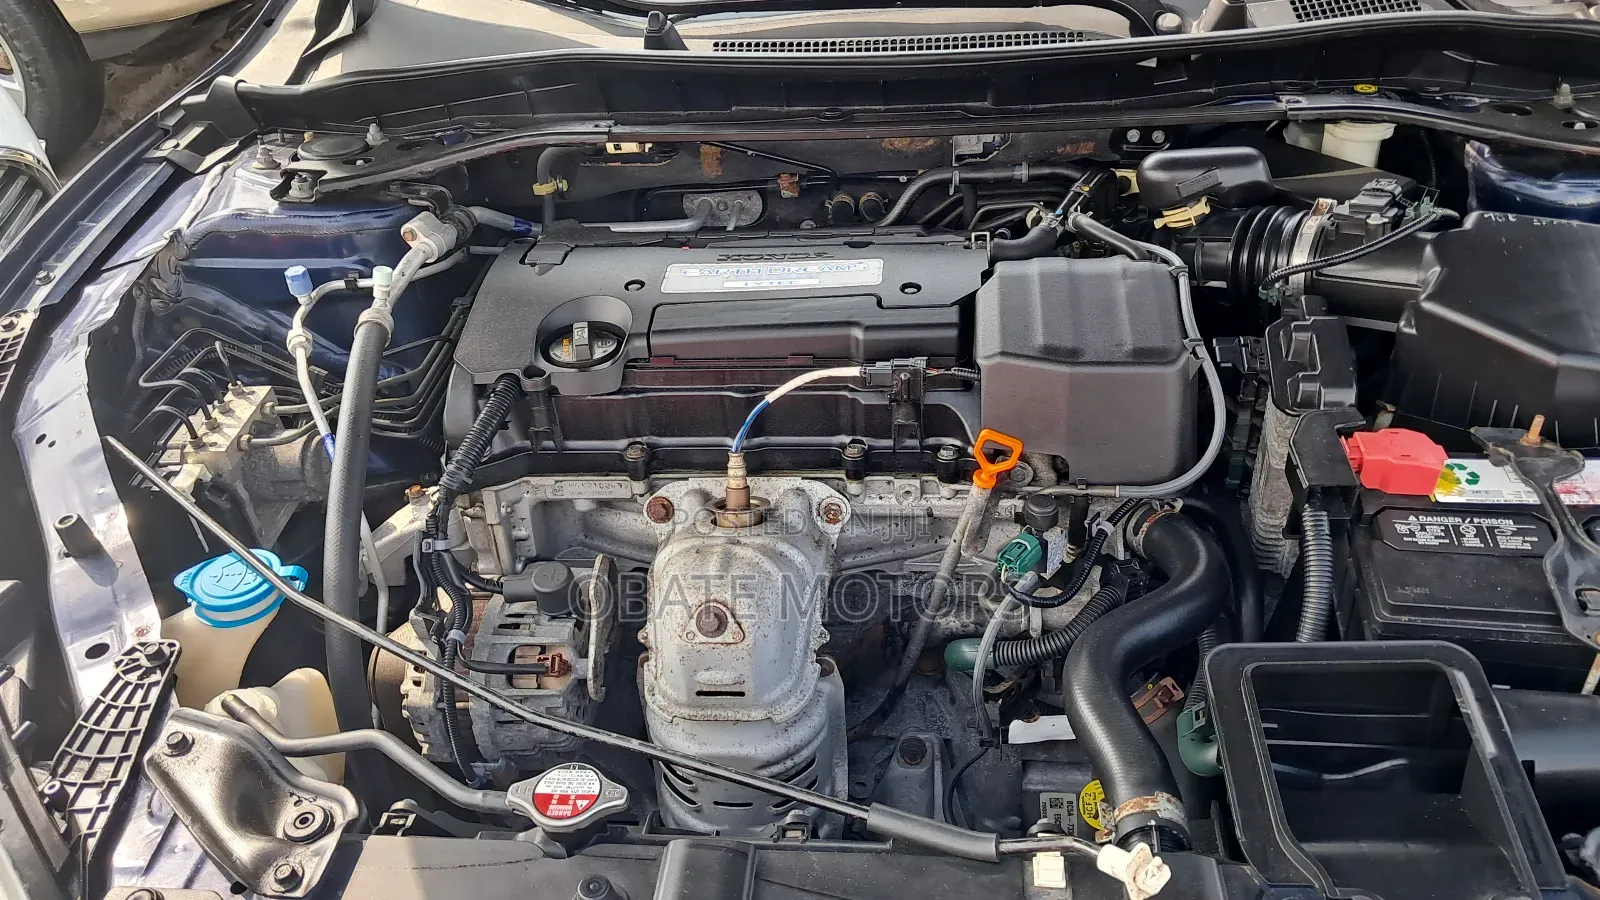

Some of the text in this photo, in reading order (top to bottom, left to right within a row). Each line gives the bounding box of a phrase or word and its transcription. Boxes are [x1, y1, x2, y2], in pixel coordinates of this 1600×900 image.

[682, 263, 868, 277] EARTH DREAMS
[1418, 516, 1463, 524] DANGER
[1473, 517, 1514, 526] POISON
[1085, 792, 1094, 819] HCF-2
